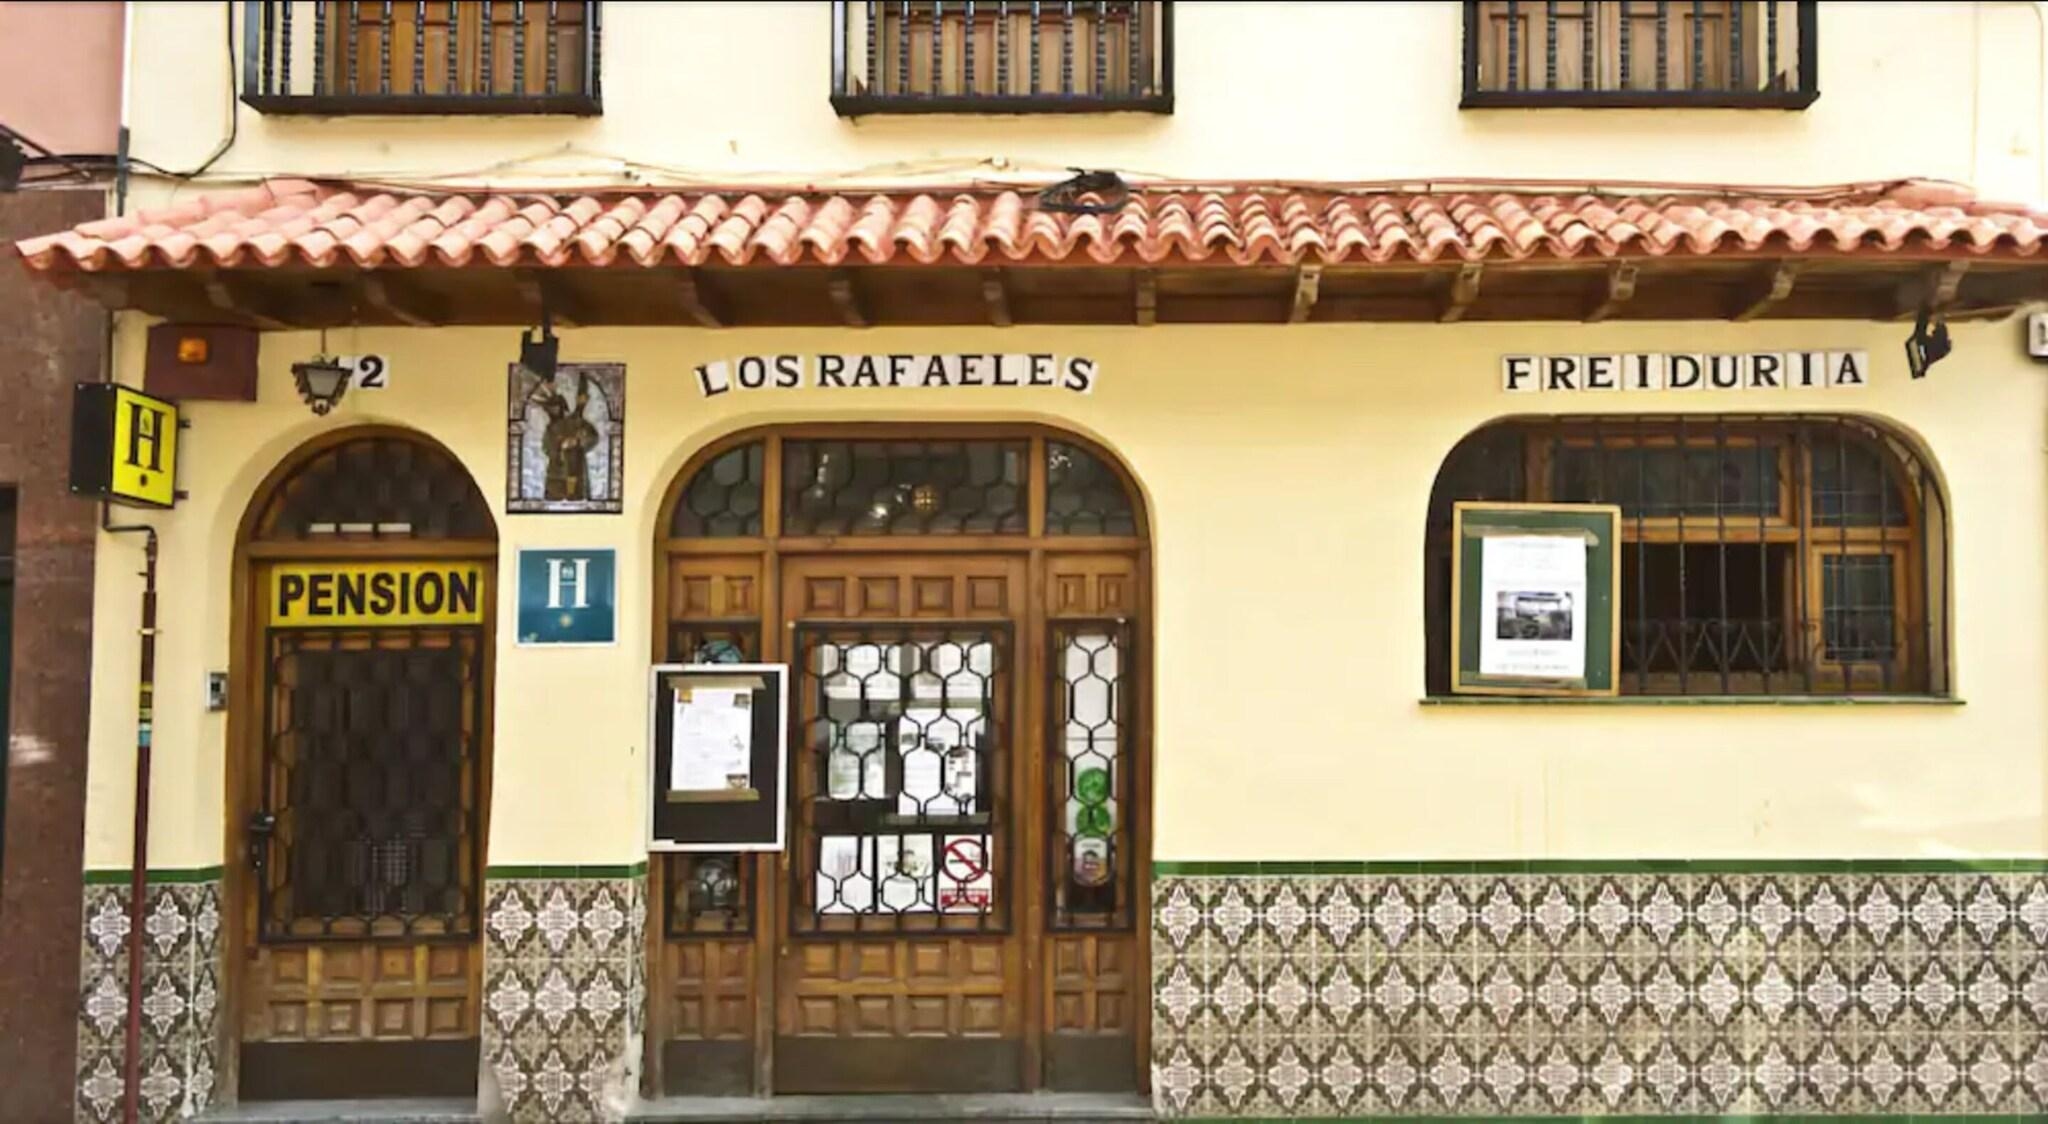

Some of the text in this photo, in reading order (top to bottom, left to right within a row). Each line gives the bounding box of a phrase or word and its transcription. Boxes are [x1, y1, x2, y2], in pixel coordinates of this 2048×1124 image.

[695, 354, 1092, 398] LOS RAFAELES
[1506, 353, 1863, 390] FREIDURIA
[279, 571, 477, 616] PENSION
